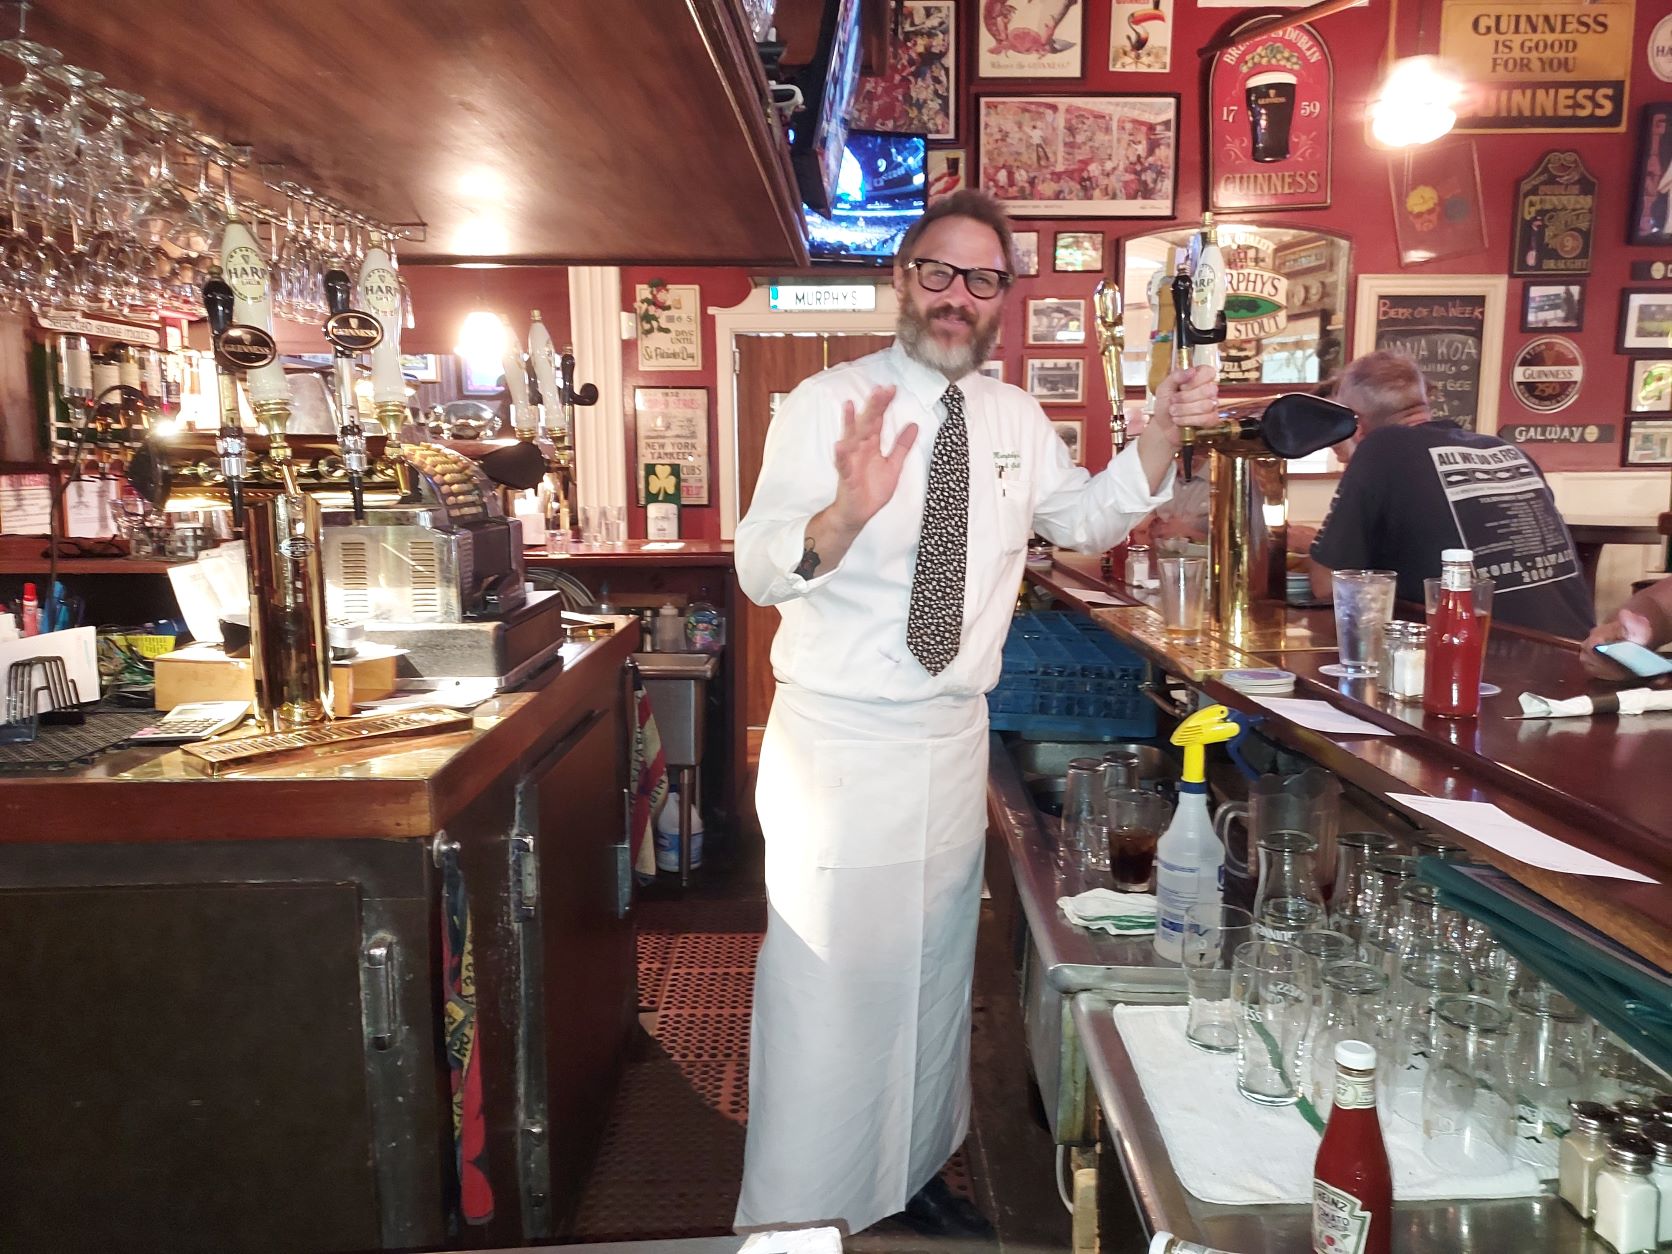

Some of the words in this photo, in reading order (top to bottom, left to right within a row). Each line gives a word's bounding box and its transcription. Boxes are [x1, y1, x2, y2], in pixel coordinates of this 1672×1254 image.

[1472, 14, 1609, 36] GUINNESS
[1284, 26, 1322, 63] DUBLIN
[1494, 40, 1514, 54] IS
[1520, 39, 1578, 54] GOOD
[1491, 57, 1533, 73] FOR
[1536, 57, 1577, 73] YOU
[1472, 88, 1614, 117] UINNESS
[1222, 105, 1238, 123] 17
[1300, 101, 1321, 118] 59
[1222, 170, 1319, 194] GUINNESS
[1194, 278, 1215, 288] RP
[1225, 271, 1281, 298] RPHYS
[795, 290, 858, 306] MURPHYS
[1414, 307, 1431, 319] OF
[1448, 299, 1485, 319] WEEK
[1233, 315, 1281, 339] STOUT
[671, 337, 695, 345] UNTIL
[1436, 339, 1478, 360] KOA
[1522, 367, 1574, 380] GUINNESS
[1514, 425, 1583, 443] GALWAY
[645, 441, 666, 451] NEW
[670, 441, 697, 451] YORK
[650, 451, 693, 461] YANKEES
[1437, 452, 1460, 467] ALL
[1488, 452, 1504, 465] IS
[681, 464, 703, 476] CUBS
[1317, 1190, 1347, 1213] HEINZ
